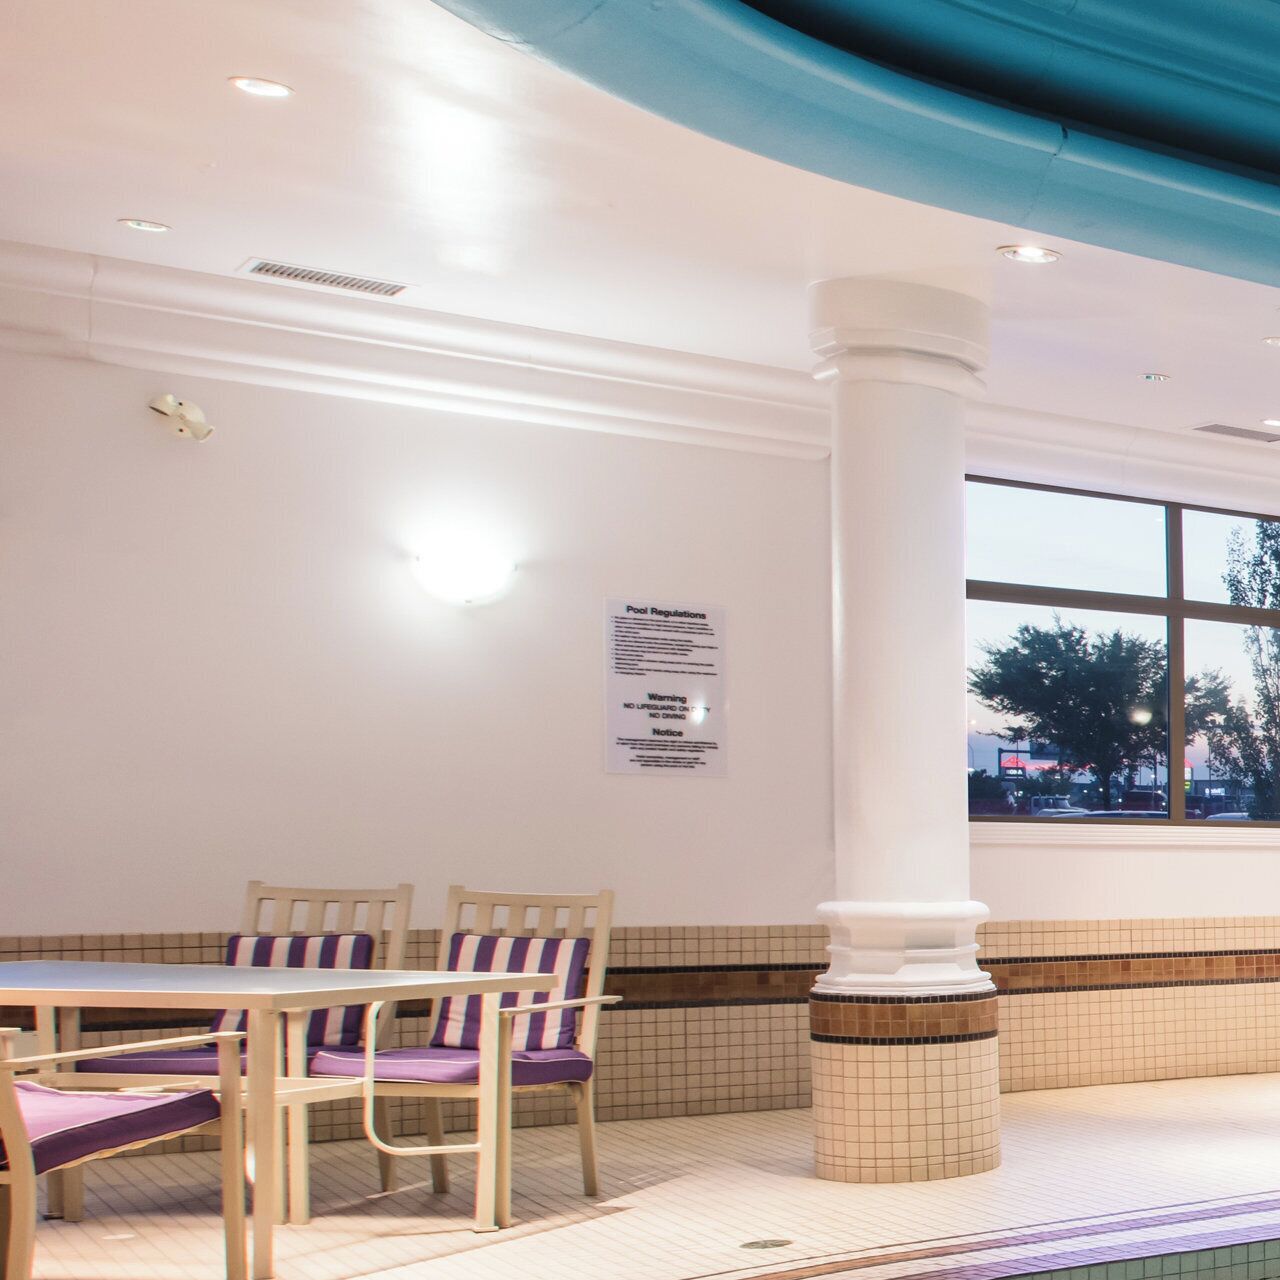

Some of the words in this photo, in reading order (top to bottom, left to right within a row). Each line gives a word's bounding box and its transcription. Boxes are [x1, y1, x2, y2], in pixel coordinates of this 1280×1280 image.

[626, 606, 648, 615] Pool
[650, 607, 707, 619] Regulations
[647, 693, 687, 704] Warning
[652, 728, 683, 737] Notice
